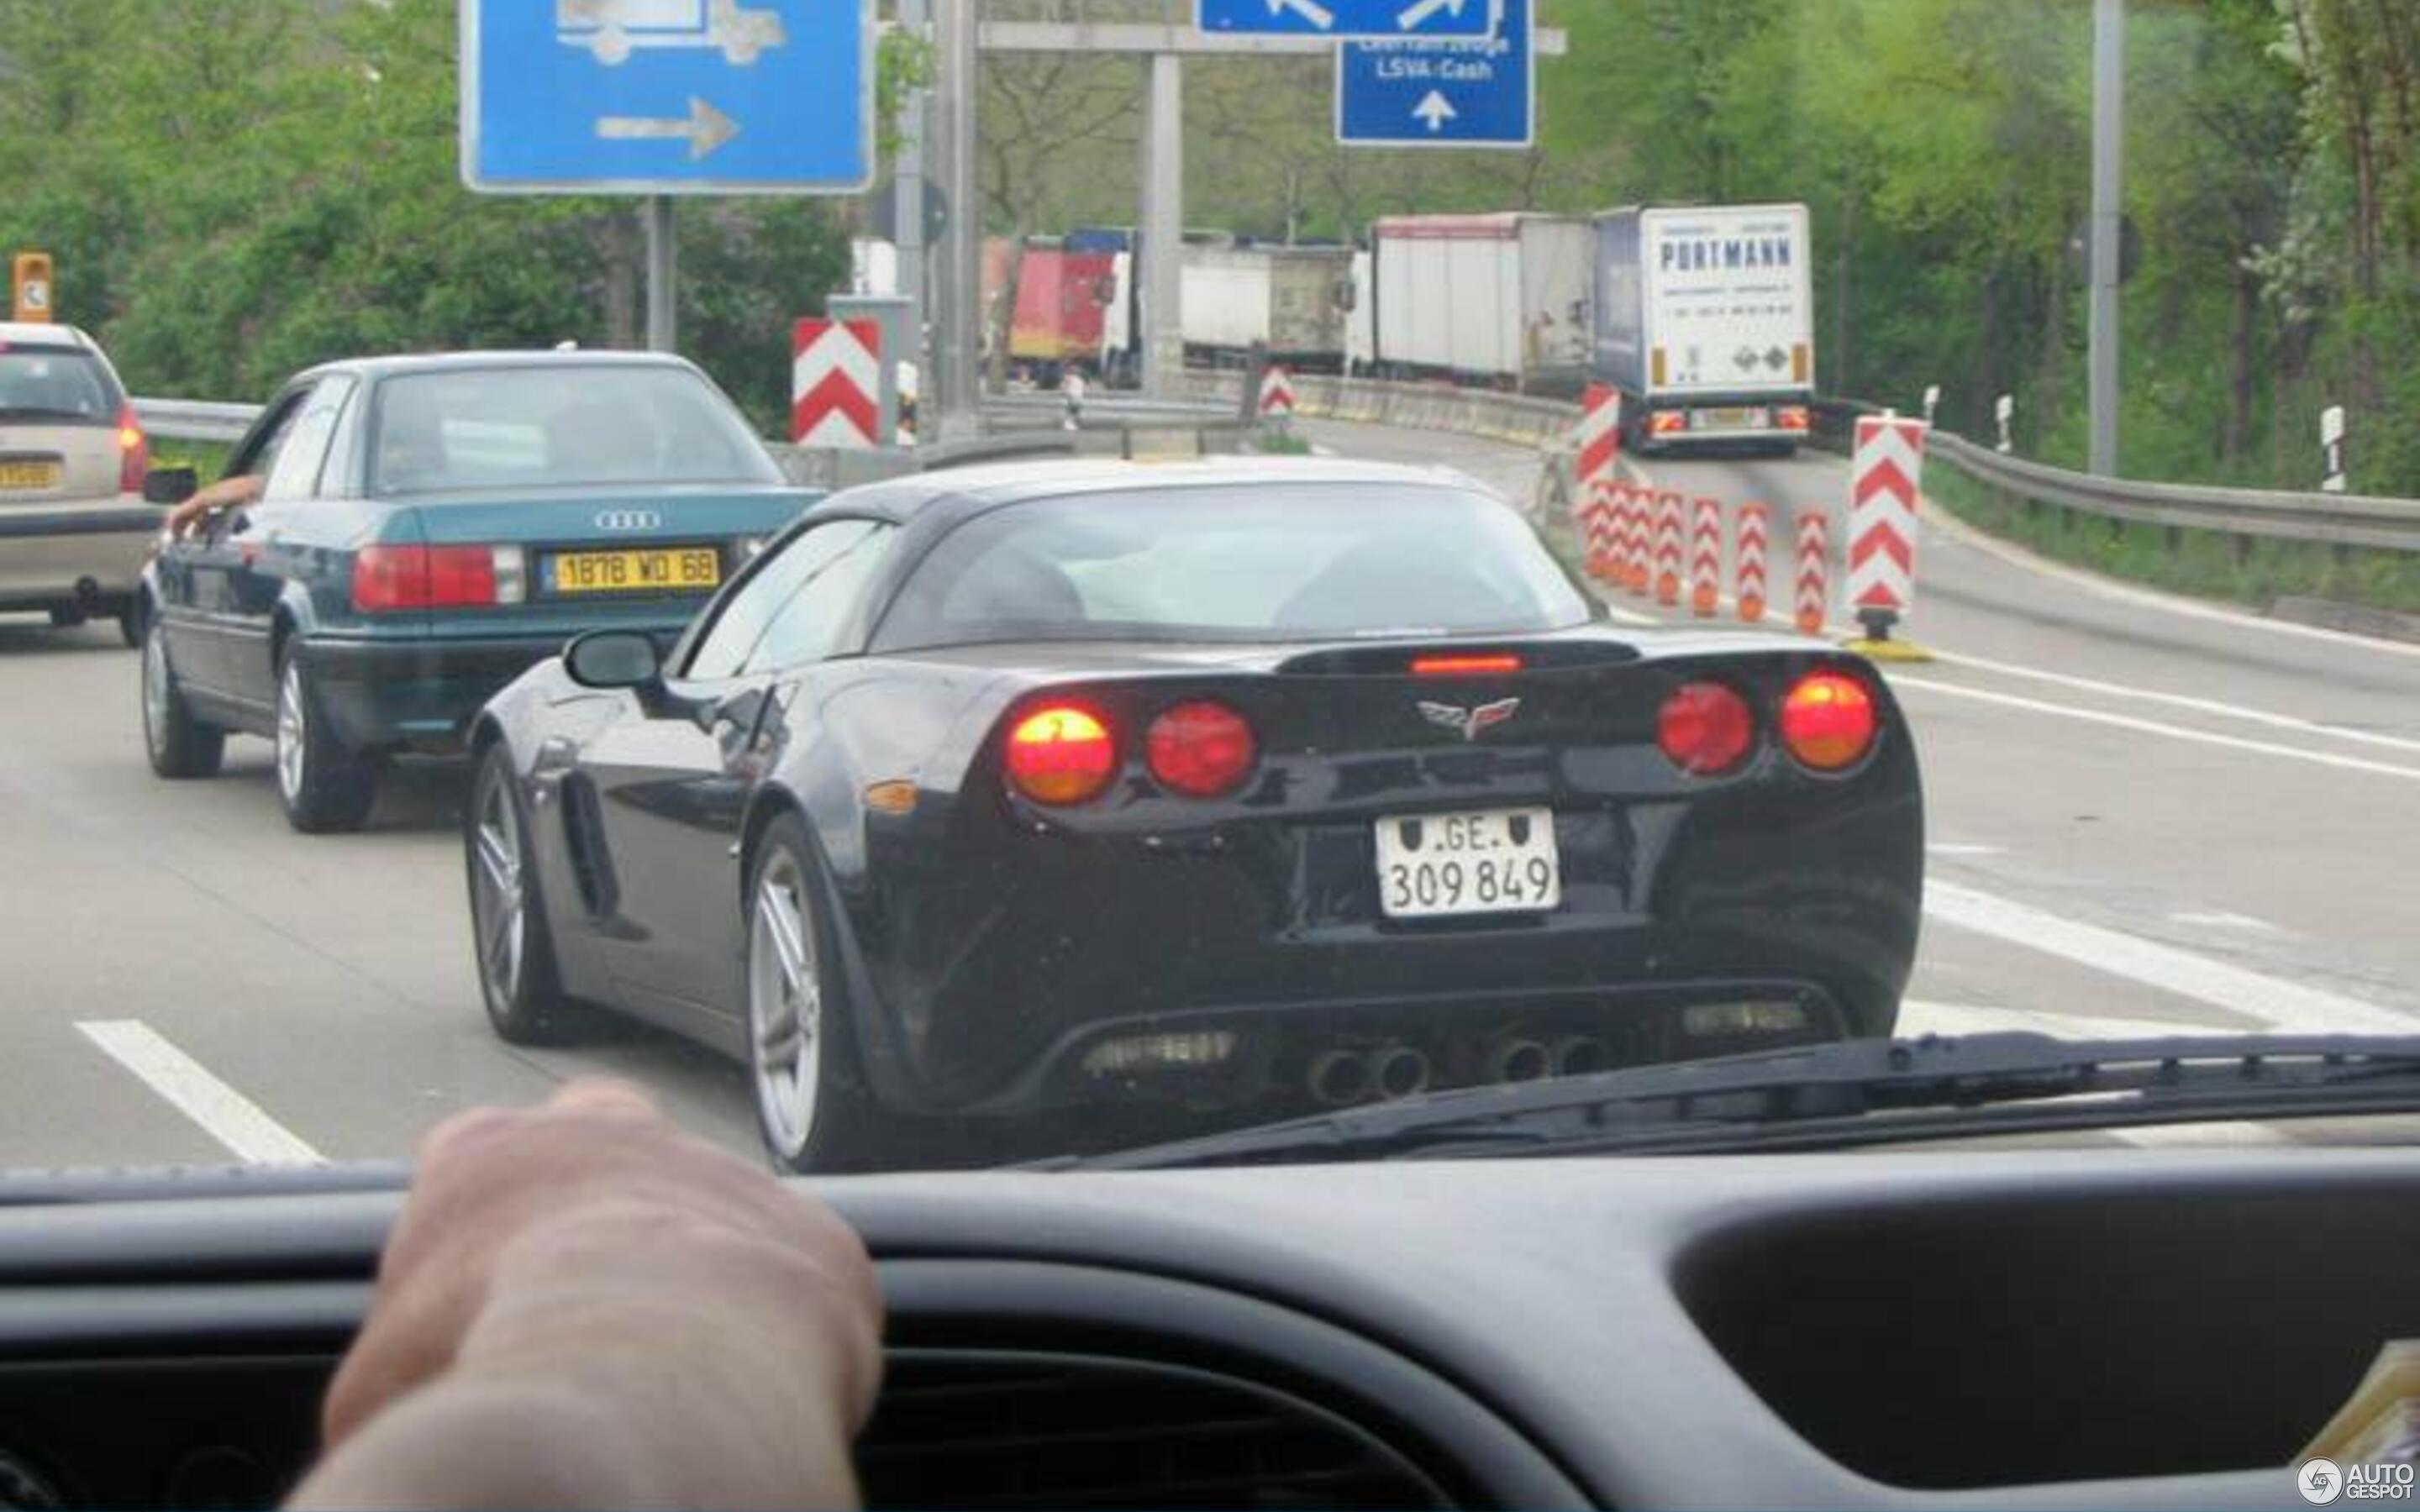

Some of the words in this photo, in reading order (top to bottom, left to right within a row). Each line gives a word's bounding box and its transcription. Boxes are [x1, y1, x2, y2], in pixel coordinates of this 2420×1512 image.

[1660, 236, 1791, 271] PORTMANN
[681, 551, 713, 581] 68
[1392, 861, 1464, 908] 309
[1476, 855, 1551, 903] 849
